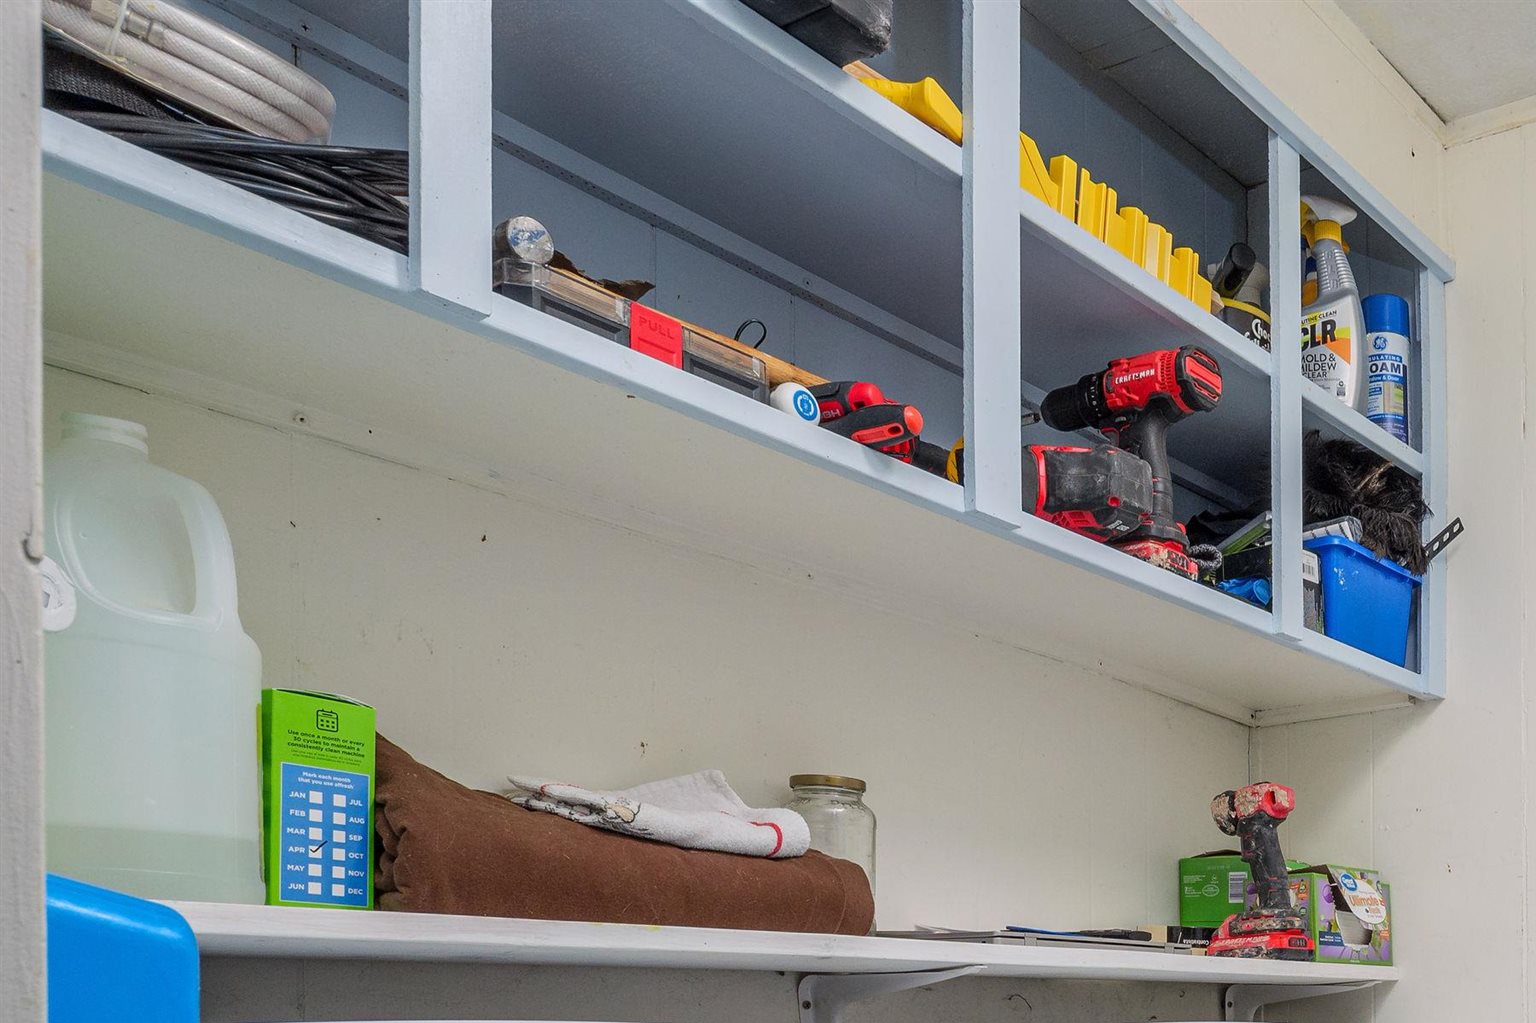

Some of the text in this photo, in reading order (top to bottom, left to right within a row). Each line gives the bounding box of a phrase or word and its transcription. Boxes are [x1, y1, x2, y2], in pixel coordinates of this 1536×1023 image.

[1319, 310, 1337, 319] CLEAN
[638, 315, 675, 340] PULL
[1328, 353, 1336, 362] &
[1370, 362, 1401, 374] OAM
[1115, 368, 1155, 385] CRAFTSMAN
[288, 742, 324, 751] consistently
[342, 750, 365, 758] machine
[331, 743, 355, 751] maintain
[333, 775, 351, 783] month
[289, 791, 363, 807] JAN JUL
[289, 809, 365, 824] FEB AUG
[286, 827, 306, 835] MAR
[288, 846, 306, 854] APR
[287, 864, 305, 872] MAY
